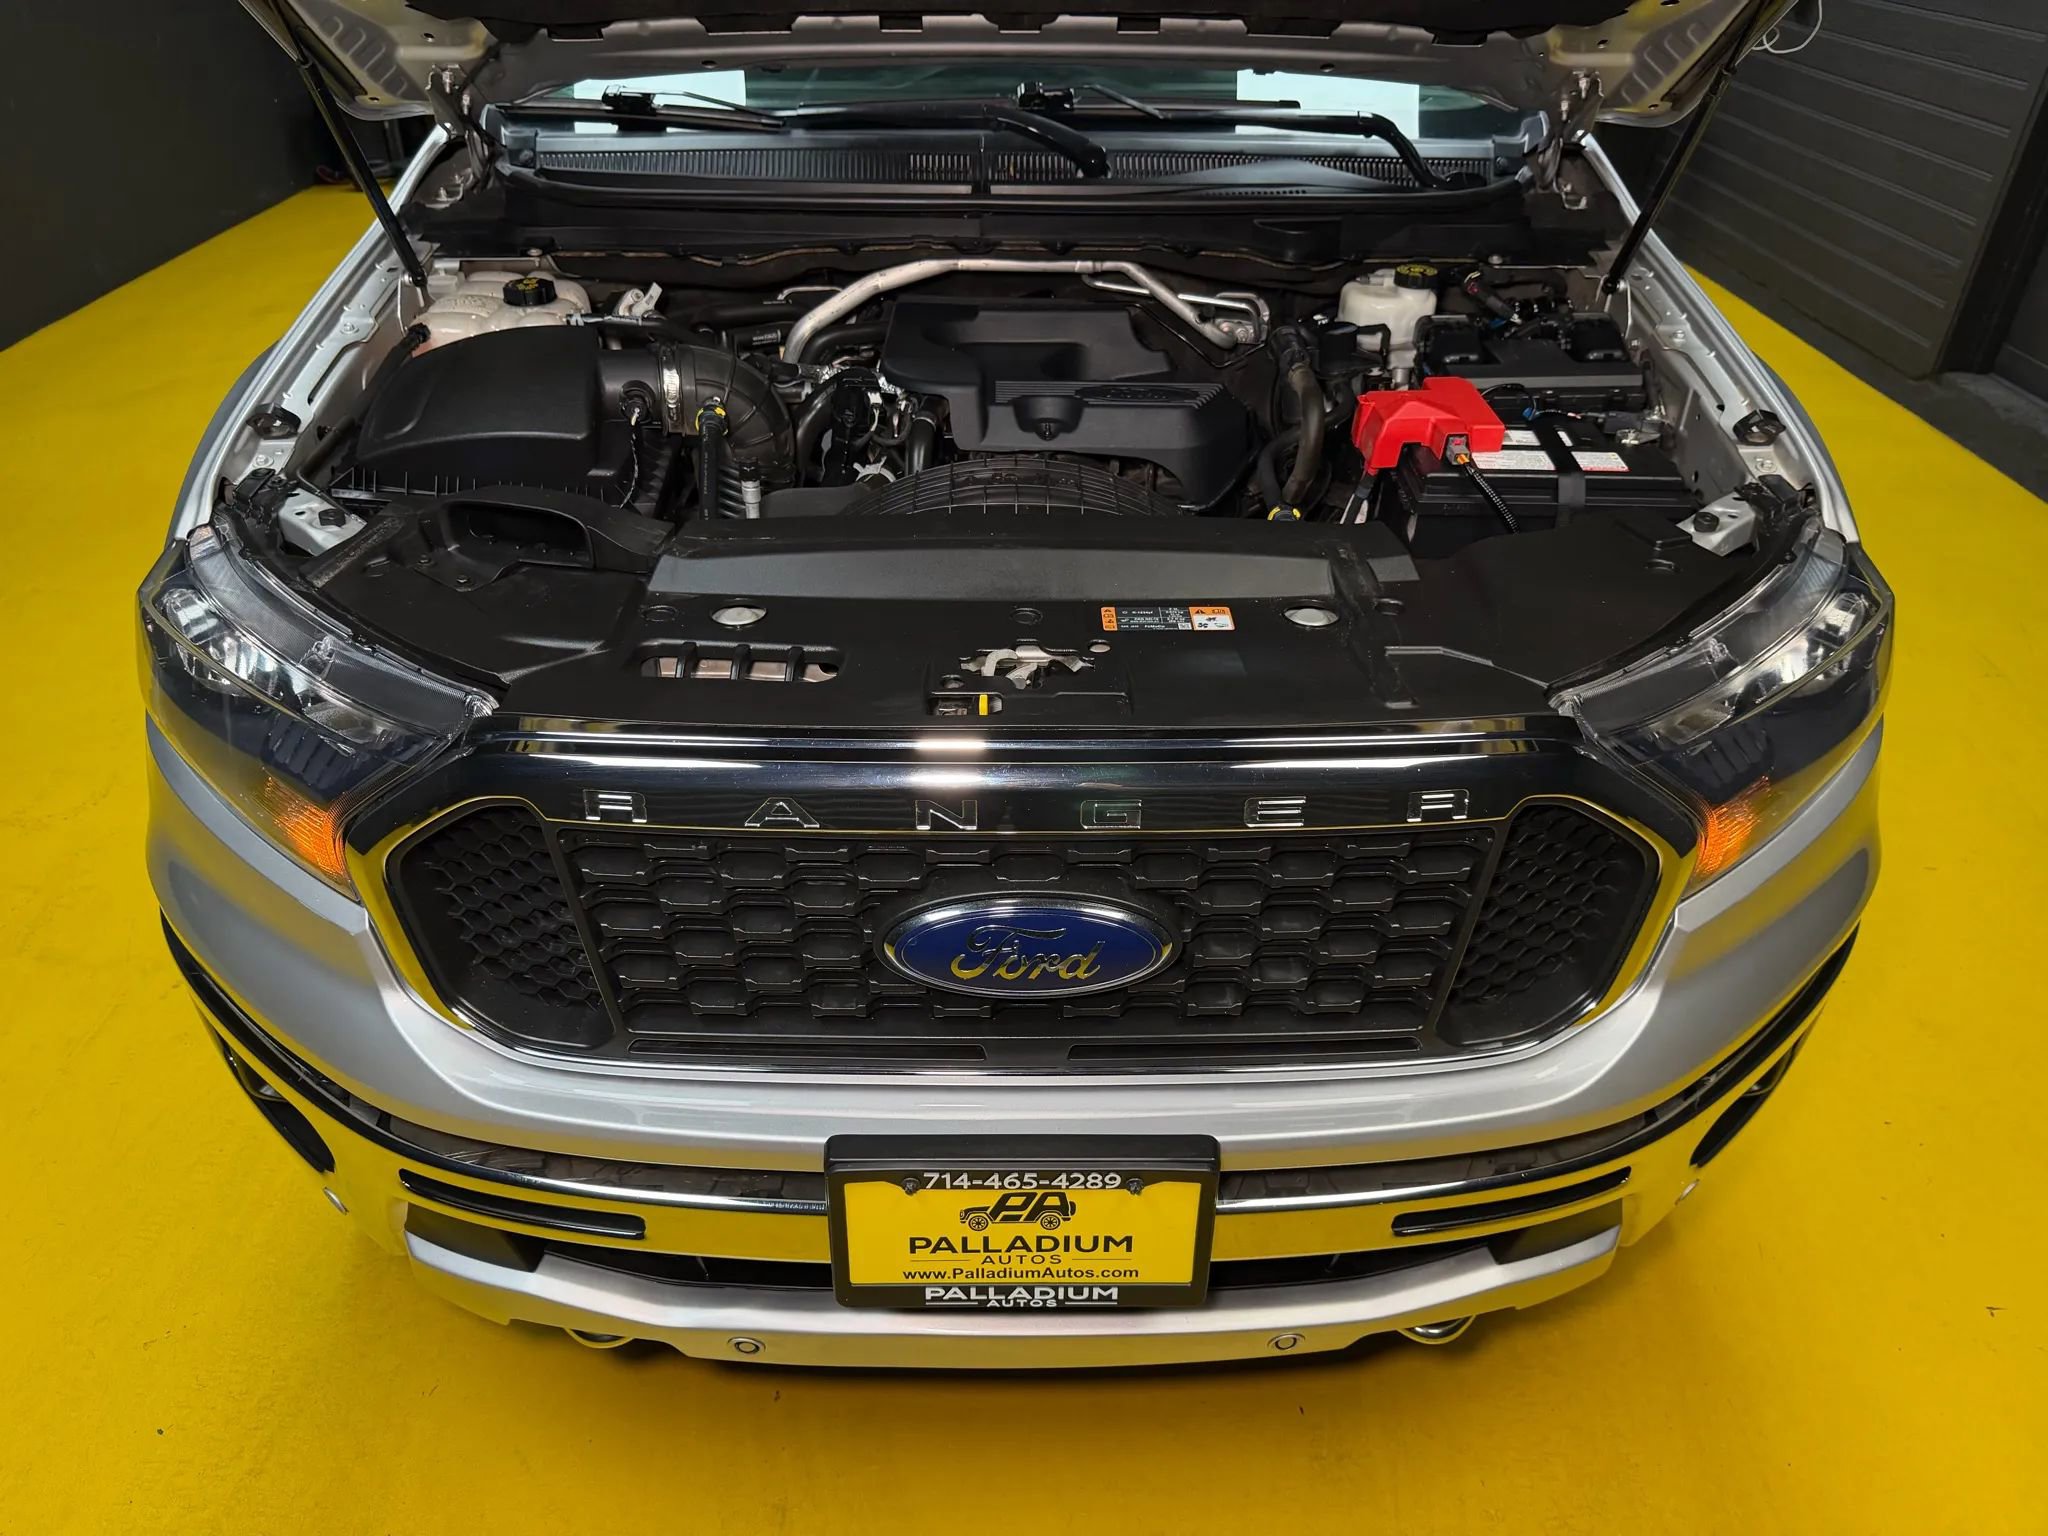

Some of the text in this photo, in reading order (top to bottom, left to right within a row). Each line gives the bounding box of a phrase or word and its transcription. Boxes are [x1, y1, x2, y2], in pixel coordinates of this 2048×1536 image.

[583, 789, 1470, 830] RANGER
[950, 924, 1105, 980] Ford
[923, 1172, 1122, 1190] 714-465-4289
[909, 1235, 1133, 1254] PALLADIUM
[981, 1255, 1062, 1265] AUTOS
[903, 1267, 1139, 1280] www.PalladiumAutos.com
[925, 1286, 1118, 1300] PALLADIUM
[986, 1300, 1057, 1308] AUTOS
